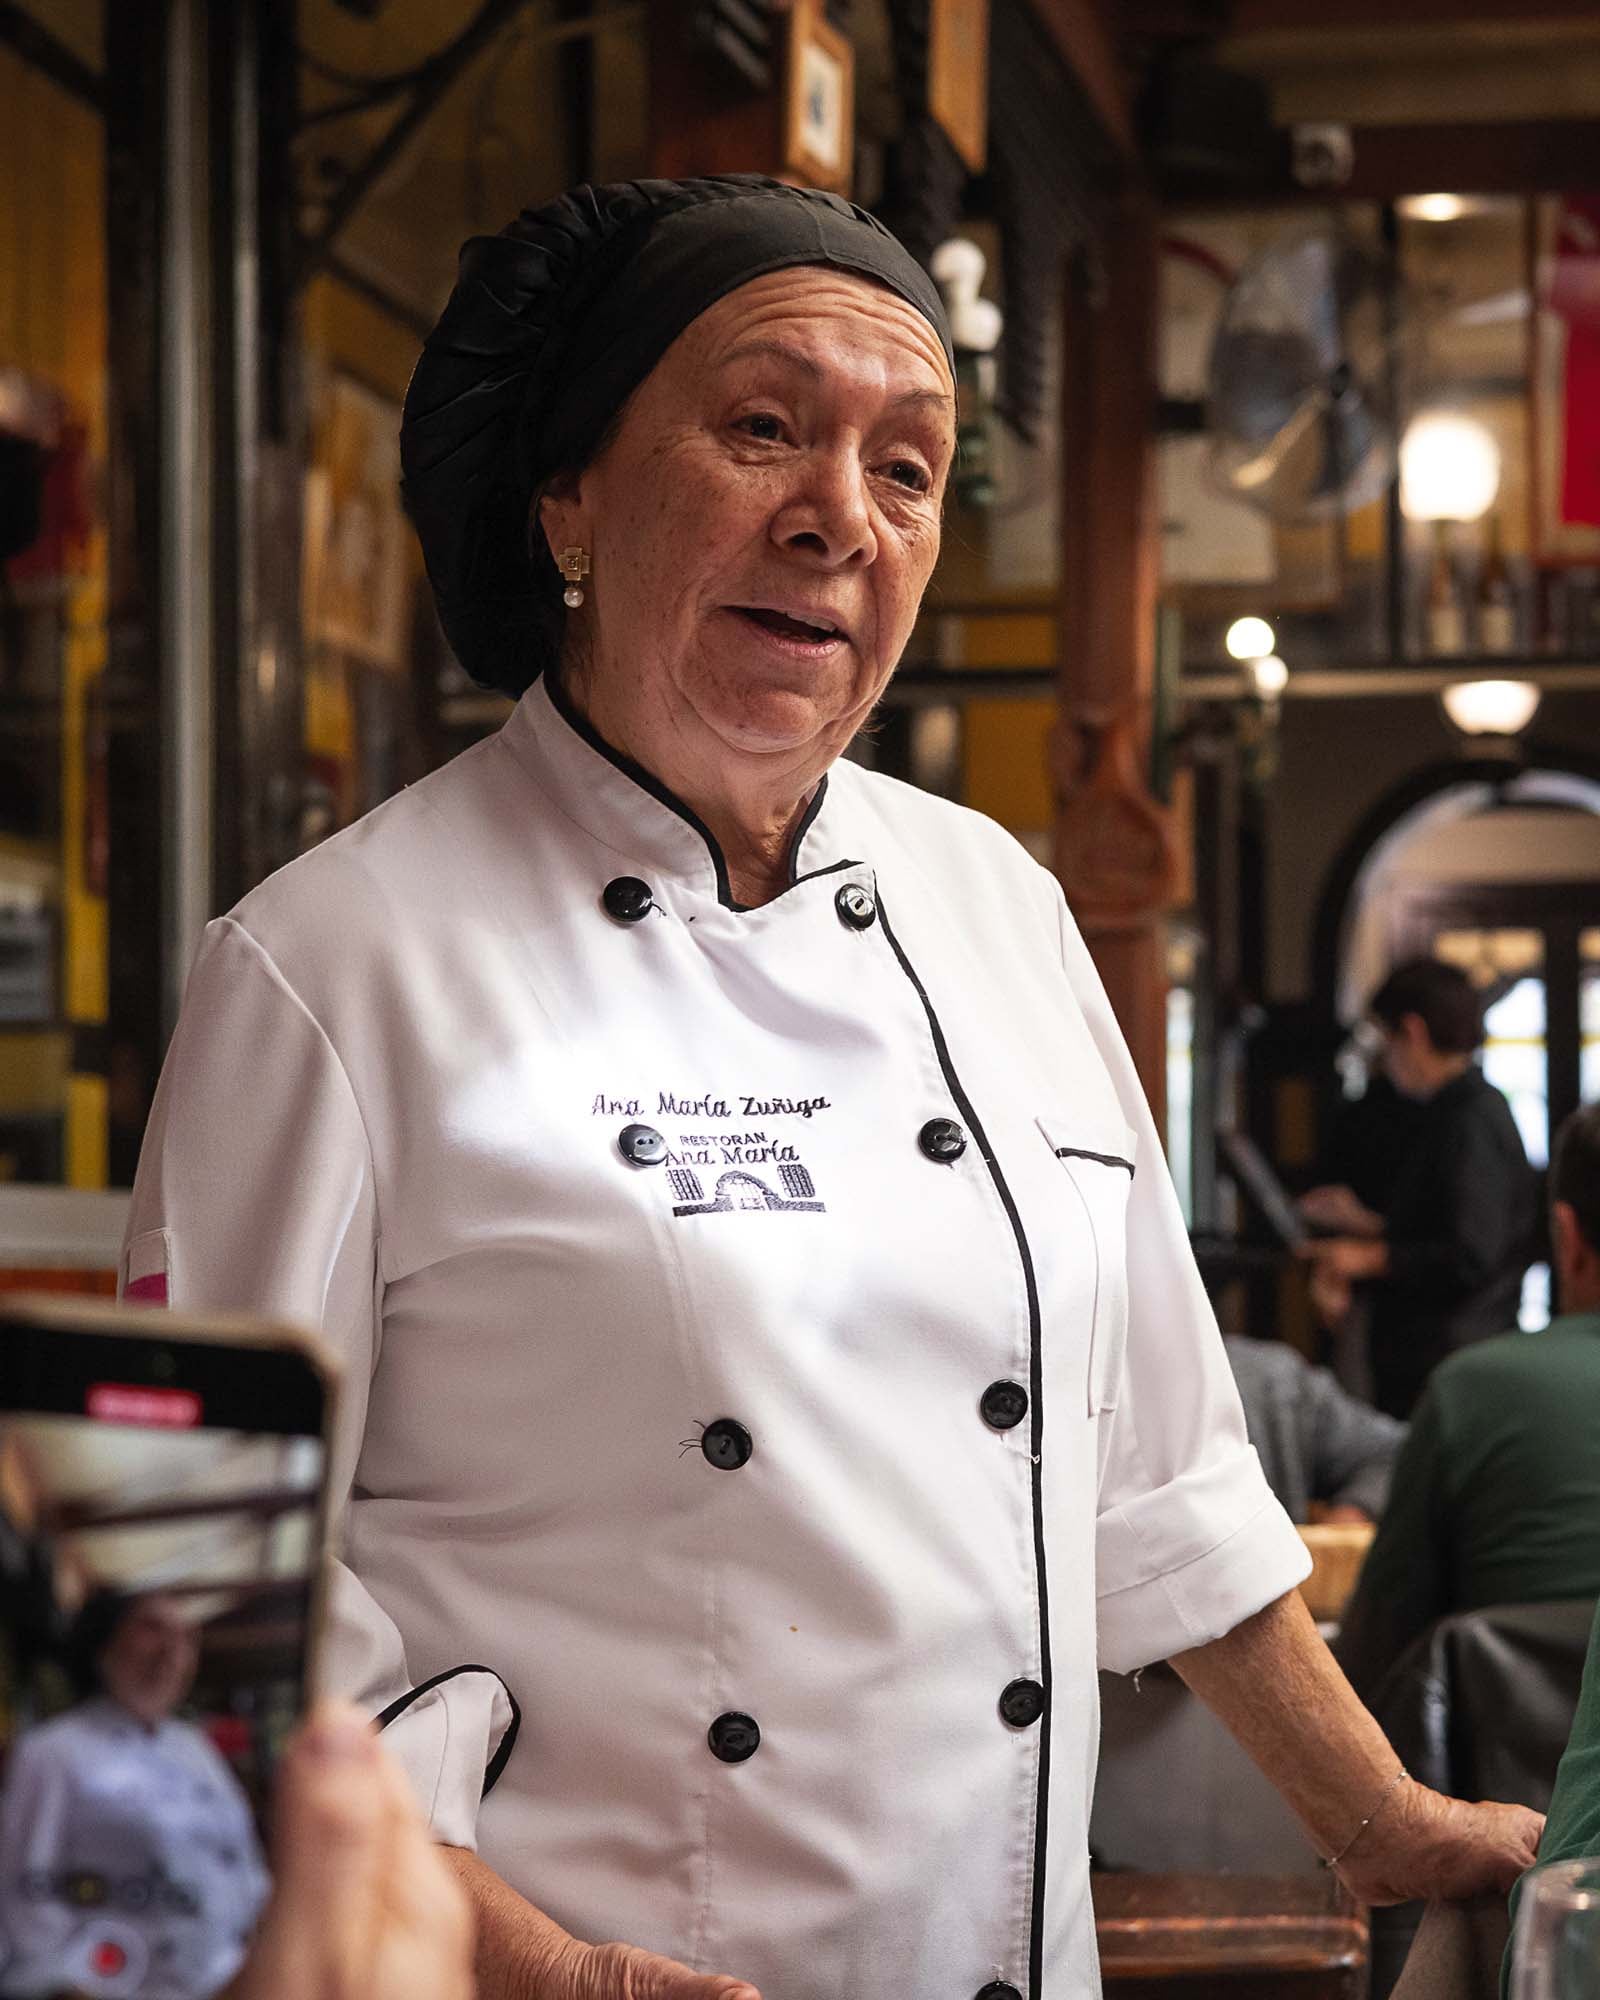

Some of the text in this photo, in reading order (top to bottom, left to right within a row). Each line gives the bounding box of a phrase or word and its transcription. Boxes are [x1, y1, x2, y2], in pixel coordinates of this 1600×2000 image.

[592, 1091, 832, 1118] Ana María Zuñiga
[680, 1131, 769, 1147] RESTORAN
[664, 1139, 801, 1167] Ana María
